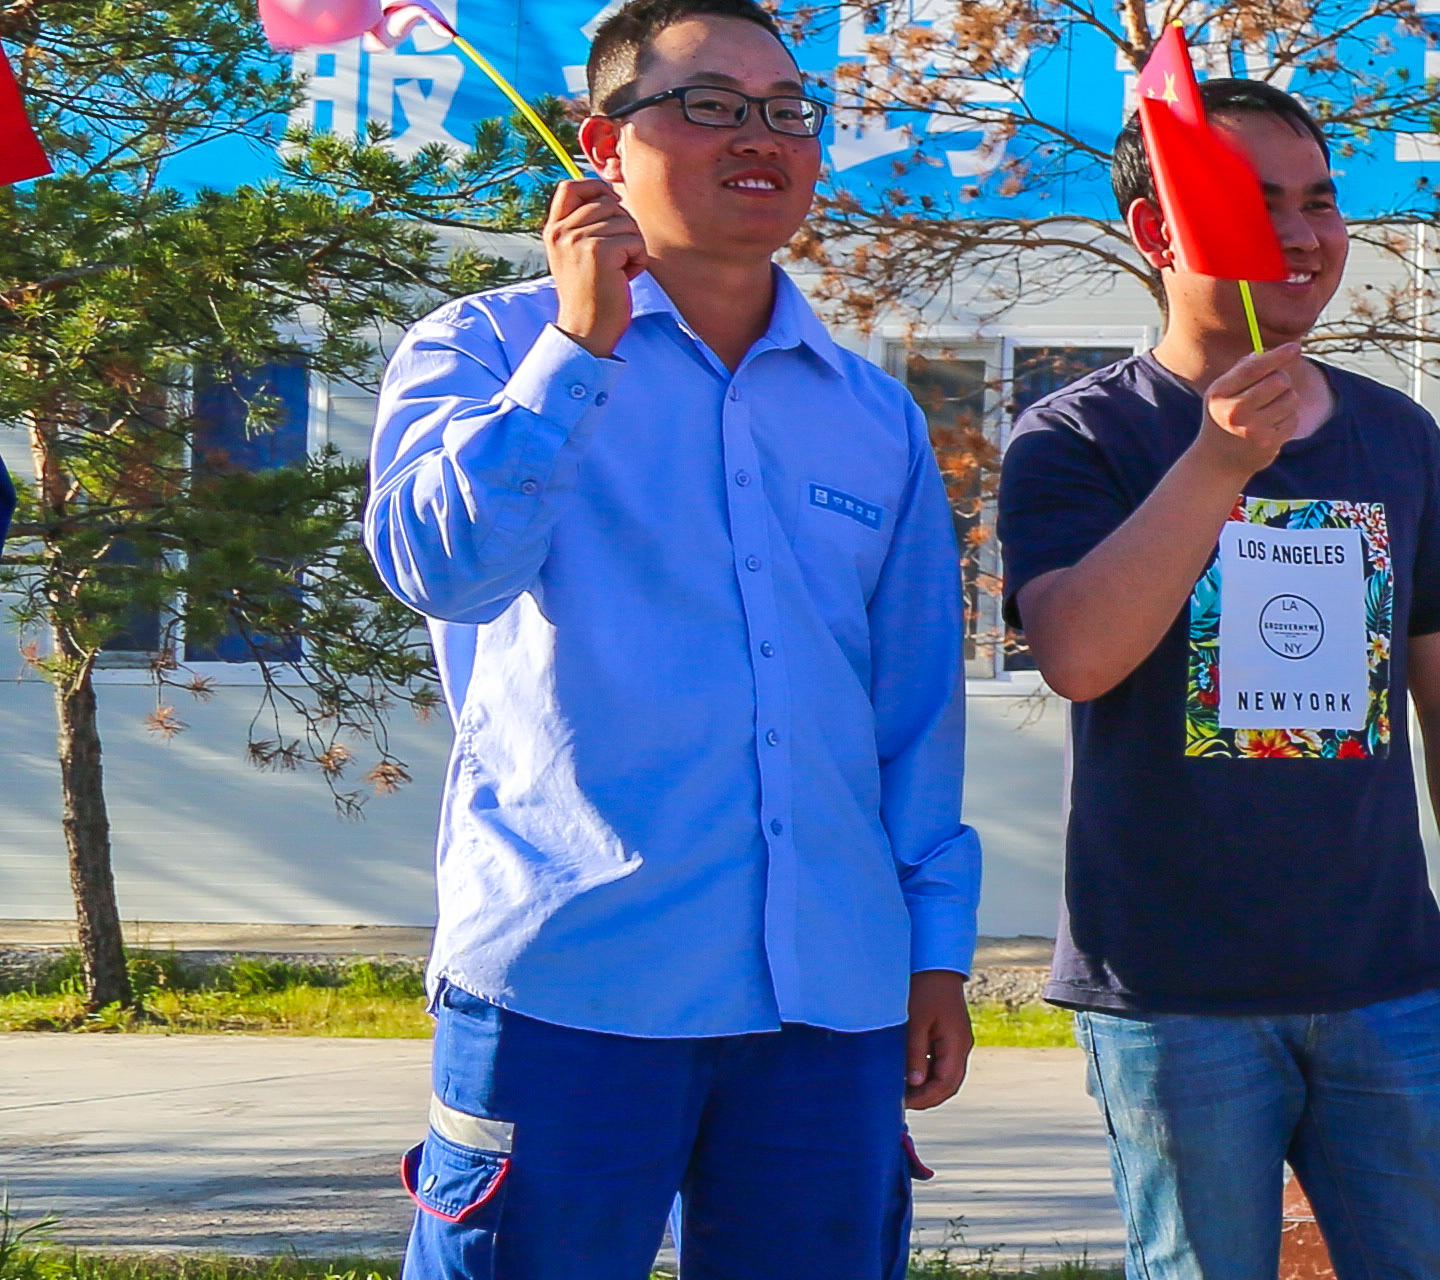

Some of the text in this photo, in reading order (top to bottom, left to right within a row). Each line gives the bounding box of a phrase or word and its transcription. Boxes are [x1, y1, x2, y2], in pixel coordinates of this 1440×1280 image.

[1238, 538, 1345, 565] LOS ANGELES
[1282, 600, 1299, 612] LA
[1284, 642, 1302, 654] NY
